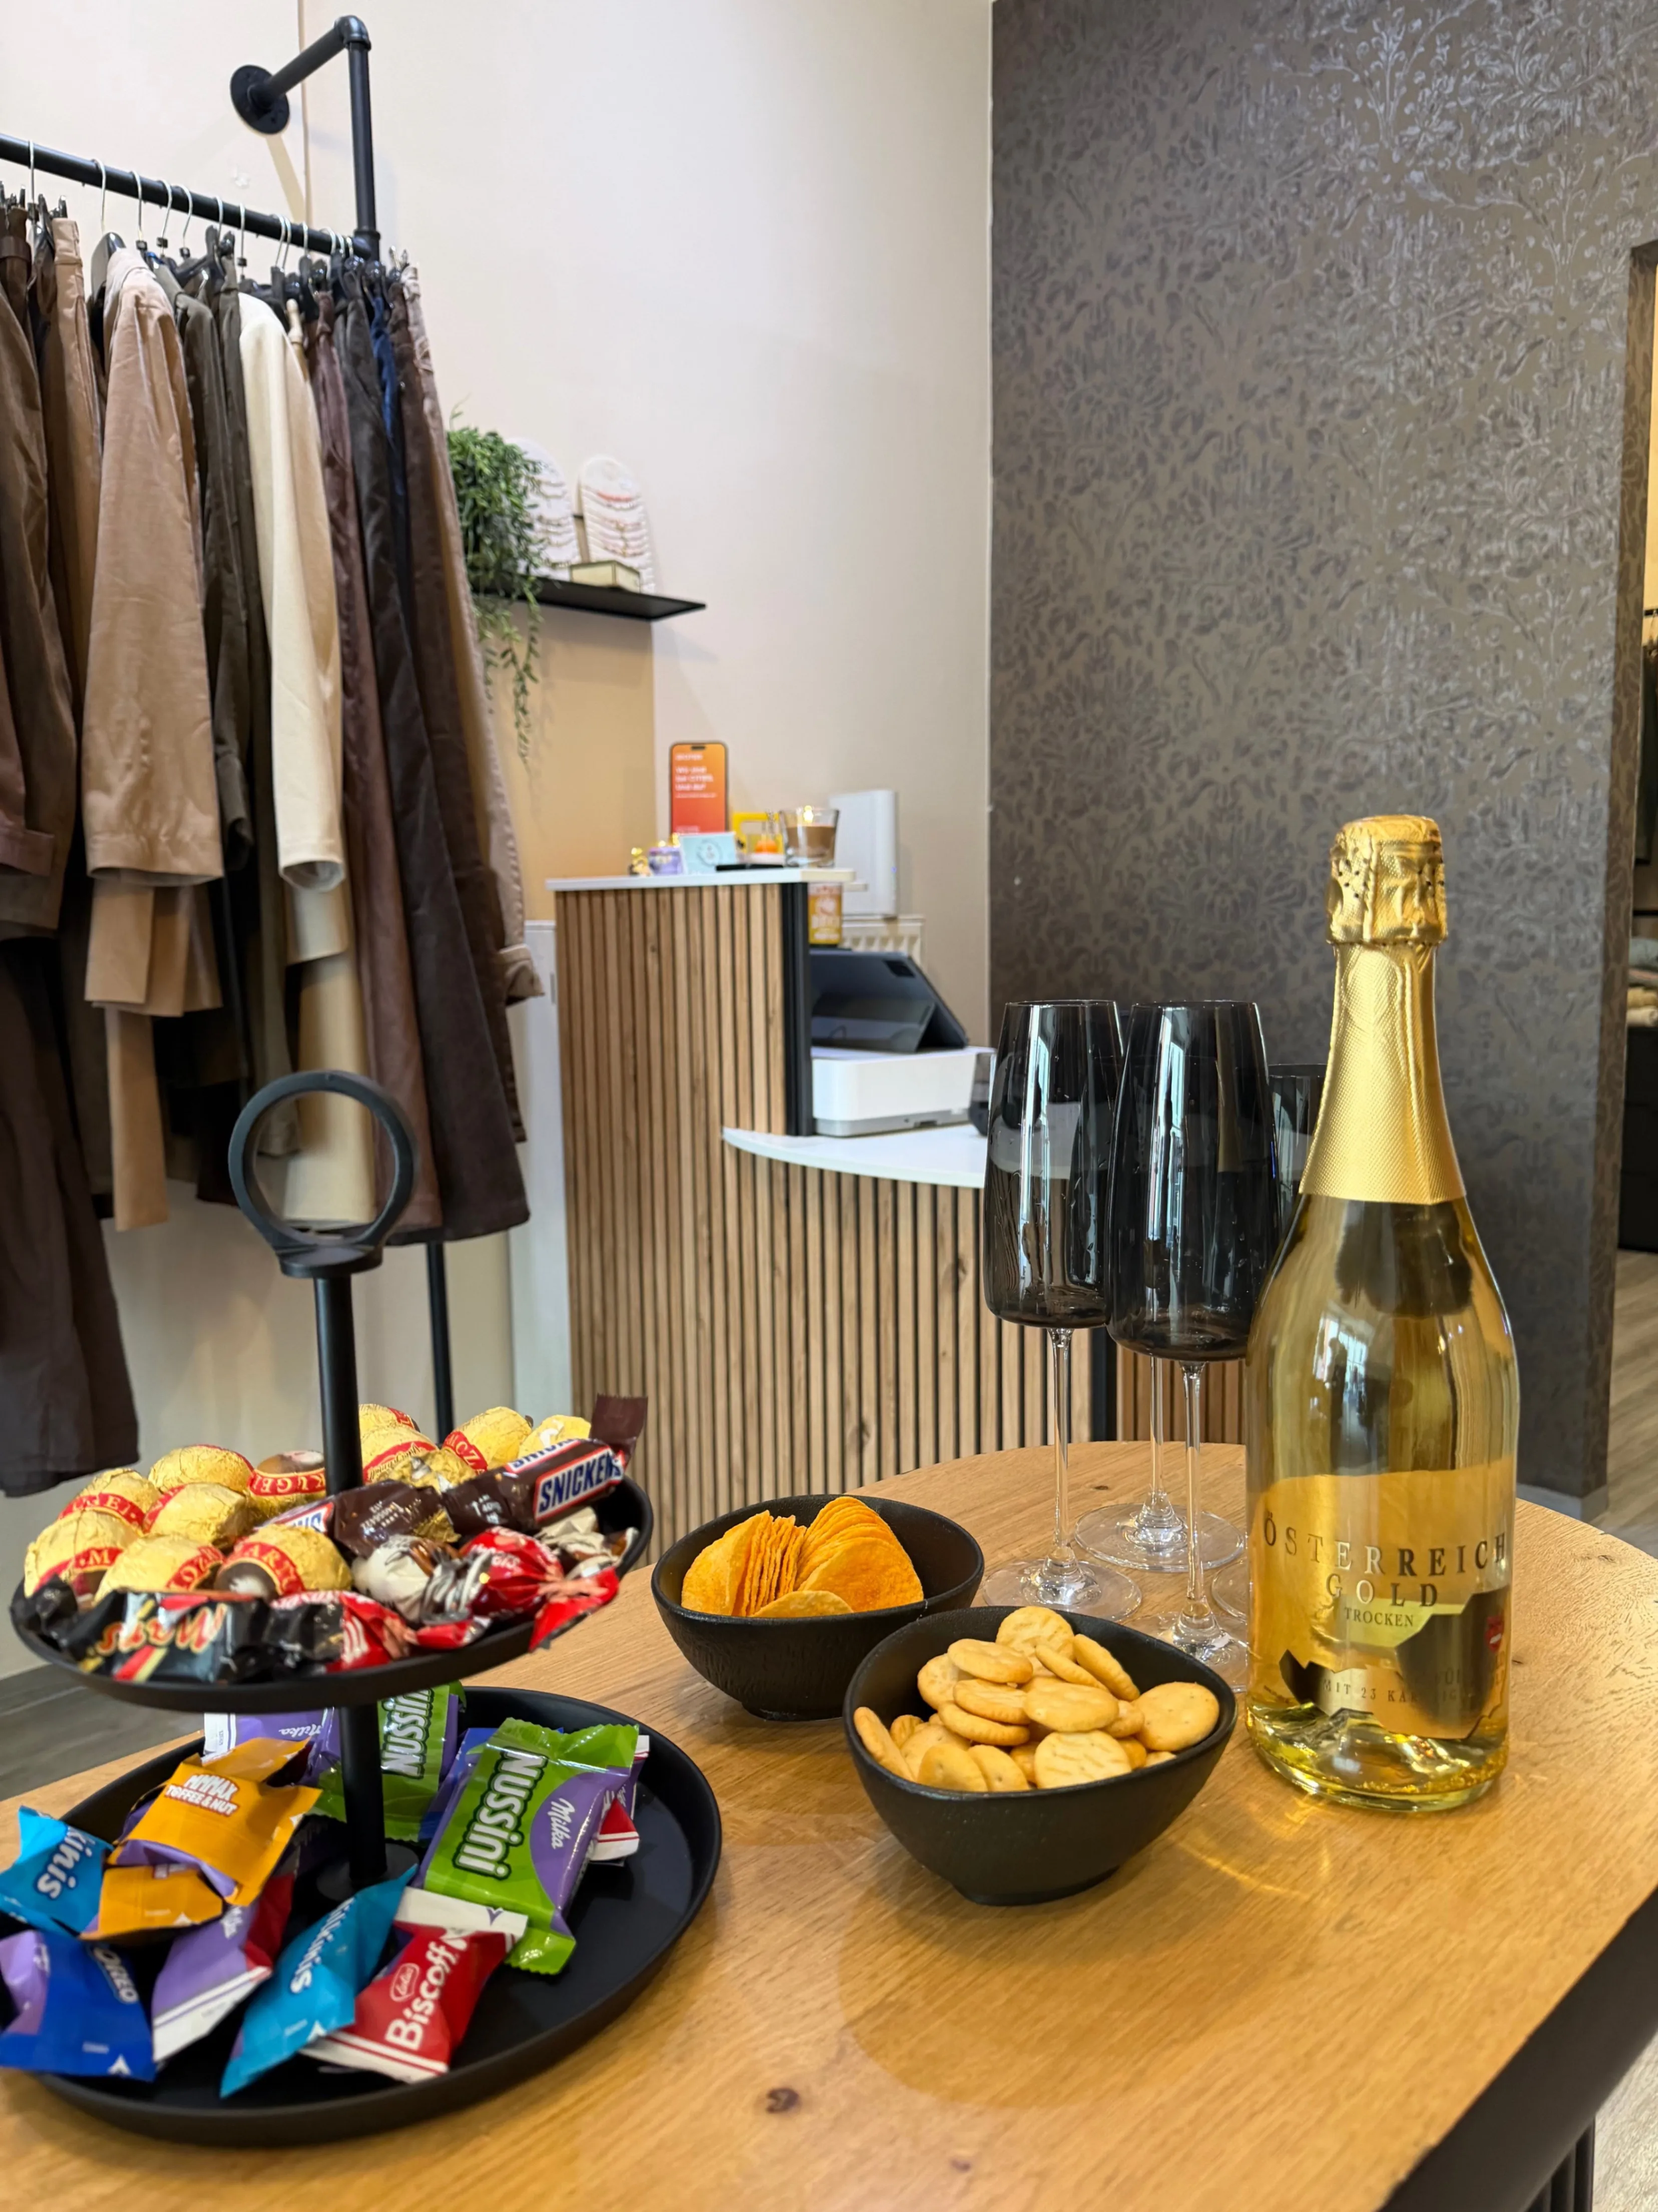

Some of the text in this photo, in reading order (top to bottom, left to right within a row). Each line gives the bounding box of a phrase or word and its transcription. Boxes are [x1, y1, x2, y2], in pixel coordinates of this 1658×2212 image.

[538, 1452, 621, 1513] SNICKERS
[1264, 1513, 1505, 1577] ÖSTERREICH
[1327, 1574, 1438, 1607] GOLD
[1344, 1606, 1414, 1627] TROCKEN
[1323, 1680, 1351, 1695] MIT
[1361, 1687, 1376, 1700] 23
[166, 1784, 238, 1815] TOFFEE & NUT
[548, 1797, 575, 1850] Milka
[384, 1941, 459, 2051] Biscoff
